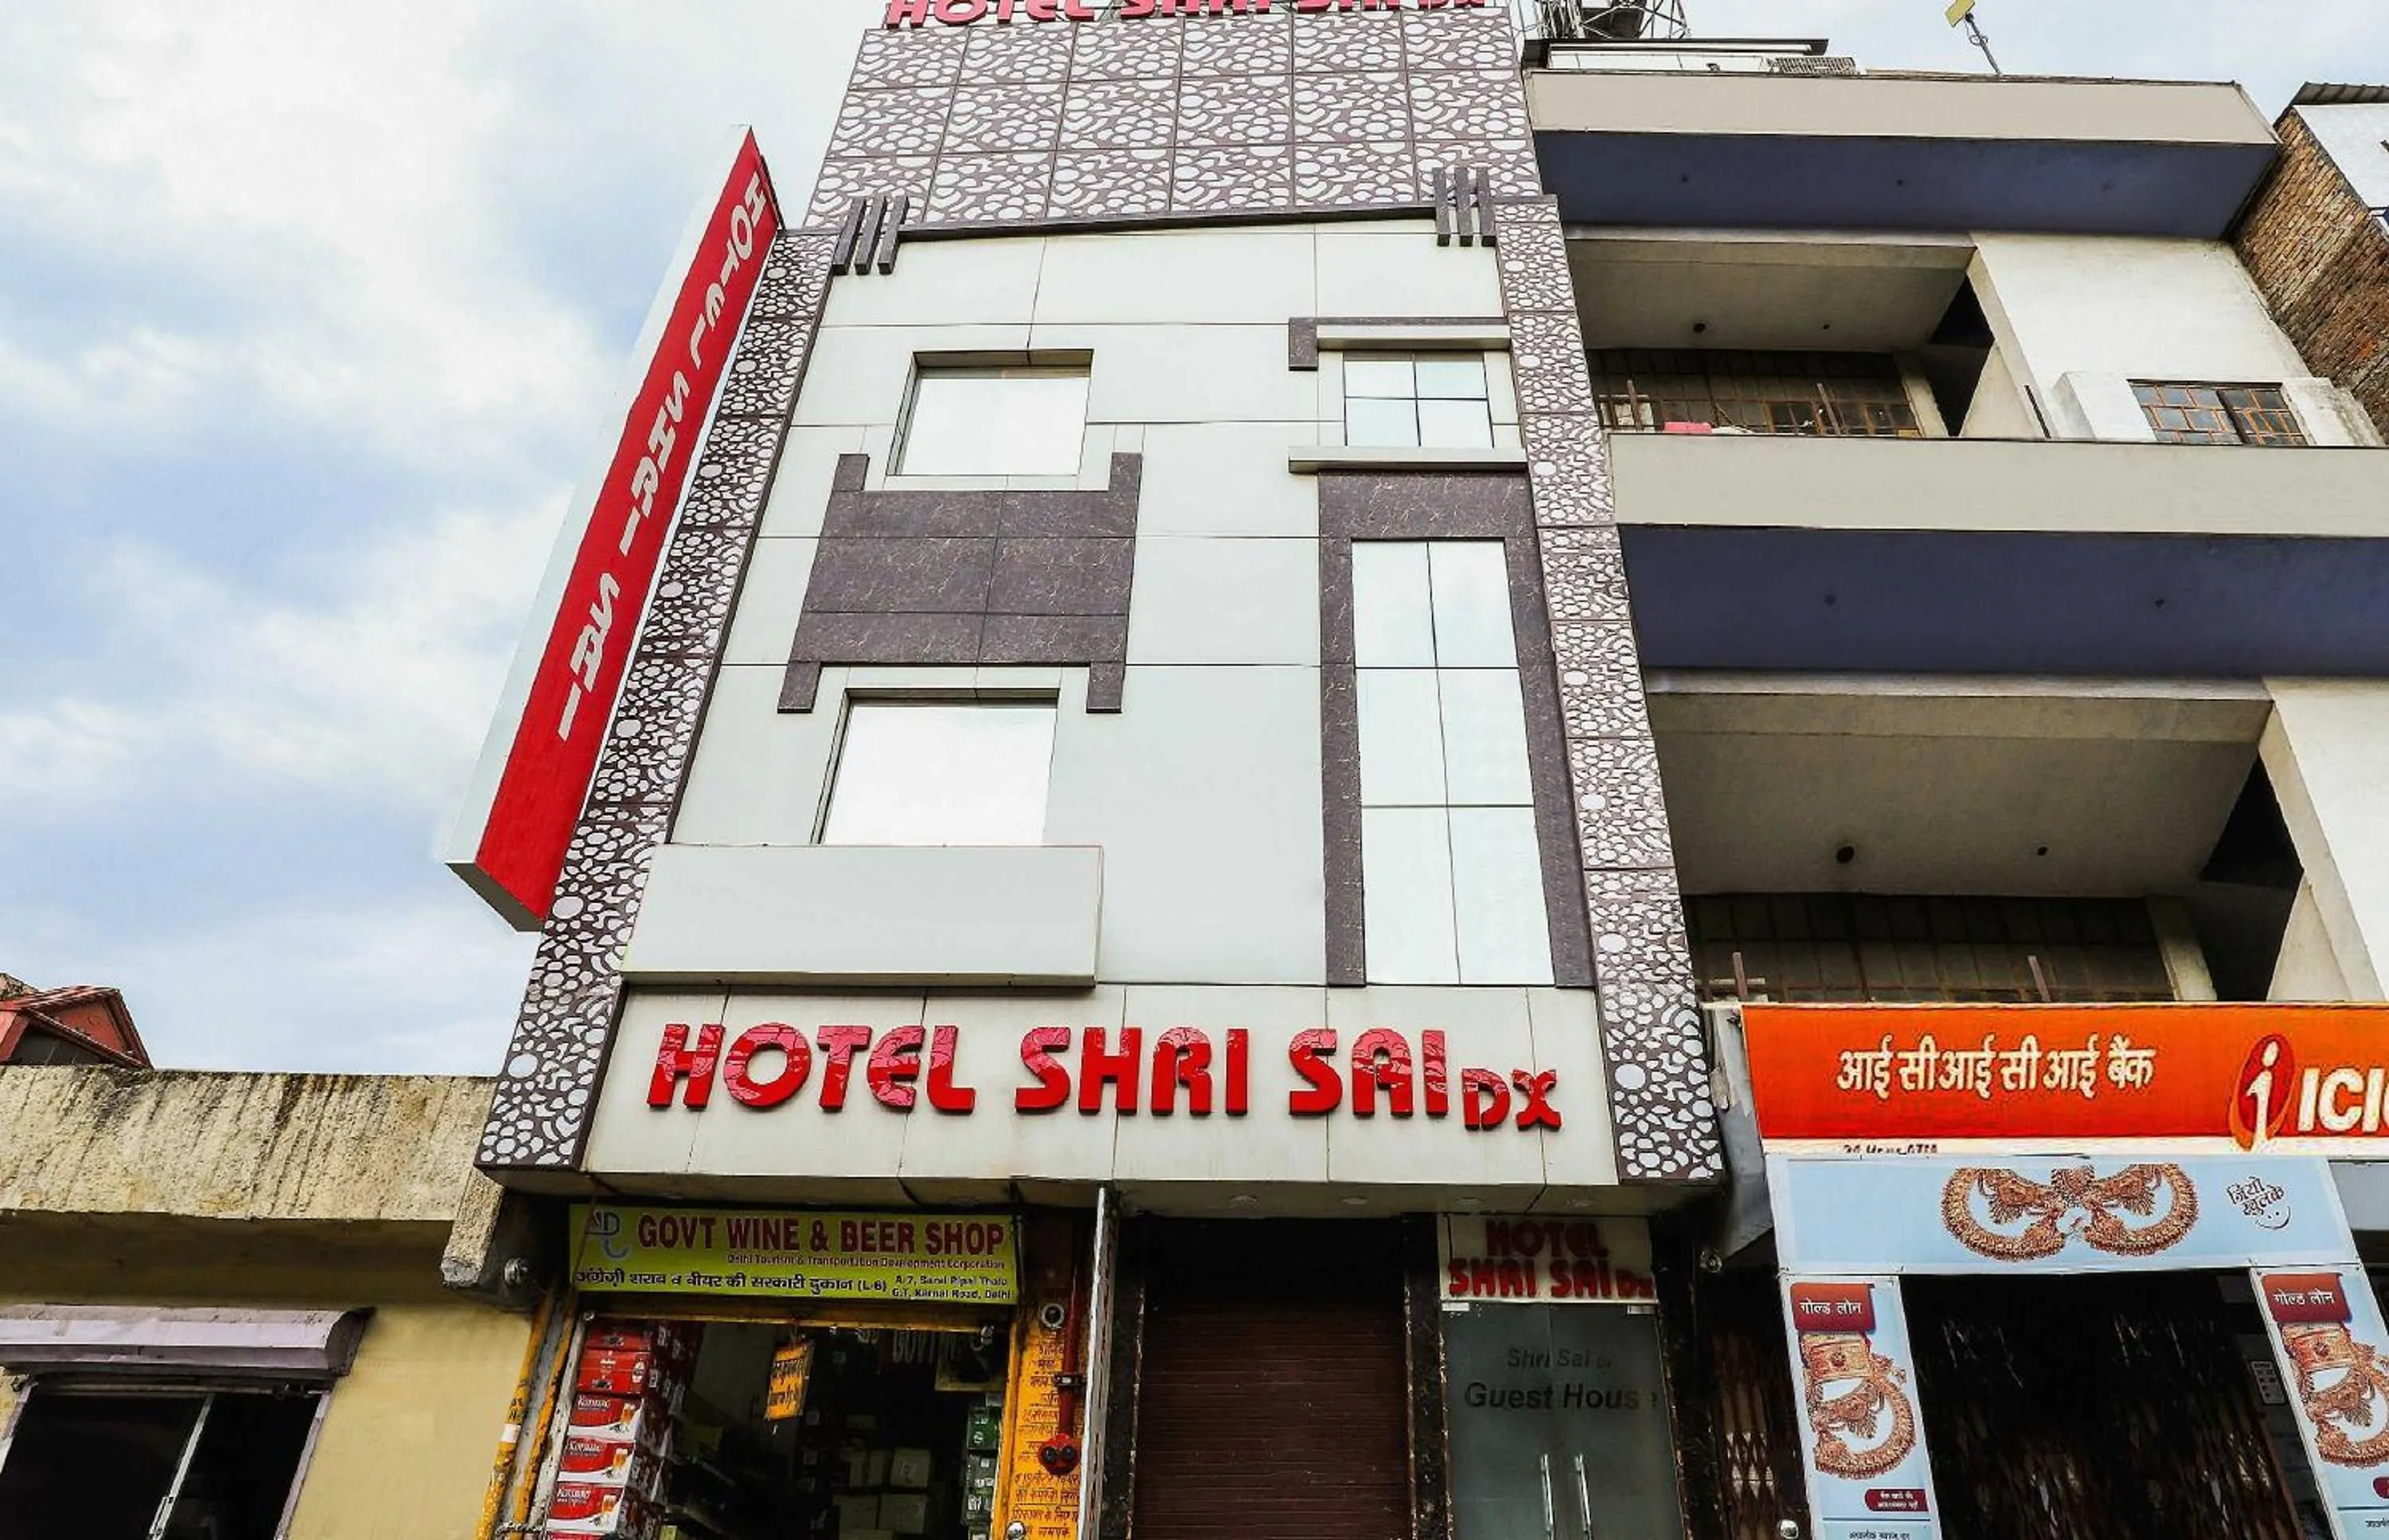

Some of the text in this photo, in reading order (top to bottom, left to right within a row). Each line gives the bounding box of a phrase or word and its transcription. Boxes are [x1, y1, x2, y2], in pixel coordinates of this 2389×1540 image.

[557, 170, 767, 741] HOTEL SHRI SAI
[647, 1023, 1562, 1132] HOTEL SHRI SAI DX
[2108, 1034, 2156, 1089] बैंक
[2297, 1067, 2389, 1132] ICI
[638, 1214, 717, 1250] GOVT
[726, 1217, 800, 1251] WINE
[809, 1219, 830, 1253] &
[841, 1219, 916, 1254] BEER
[925, 1221, 1005, 1257] SHOP
[1486, 1220, 1608, 1257] HOTEL
[726, 1272, 746, 1288] की
[751, 1273, 806, 1289] सरकारी
[809, 1276, 852, 1295] दुकान
[1449, 1258, 1538, 1297] SHRI
[1550, 1259, 1611, 1297] SAI
[1799, 1296, 1863, 1315] गोल्ड लोन
[1506, 1348, 1552, 1369] Shri
[1464, 1382, 1554, 1409] Guest
